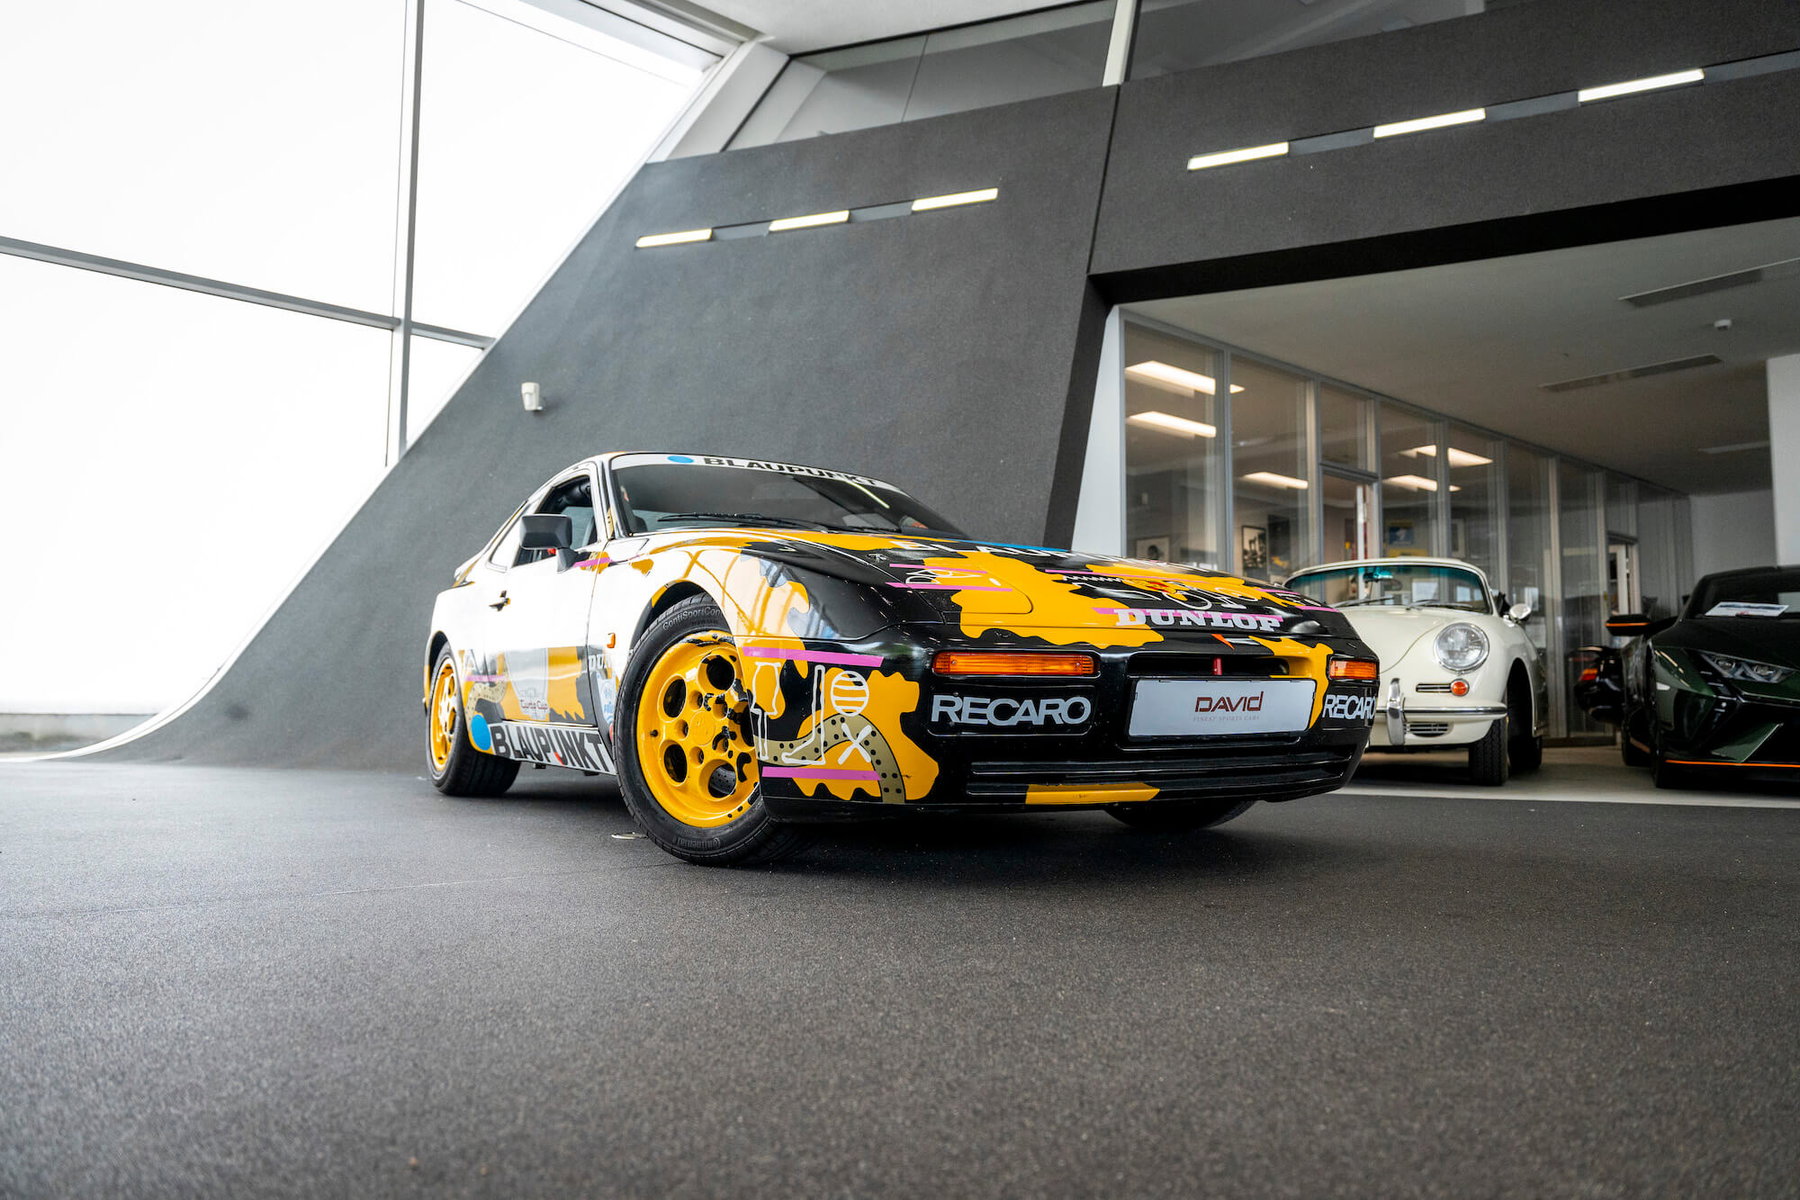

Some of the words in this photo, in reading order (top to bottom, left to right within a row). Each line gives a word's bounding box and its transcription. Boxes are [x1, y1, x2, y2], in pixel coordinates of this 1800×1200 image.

[703, 456, 876, 487] BLAUPUNKT
[662, 606, 721, 631] ContiSportCon
[1113, 608, 1284, 632] DUNLOP
[930, 694, 1092, 726] RECARO
[1322, 694, 1377, 719] RECARO
[490, 725, 611, 773] BLAUPUNKT
